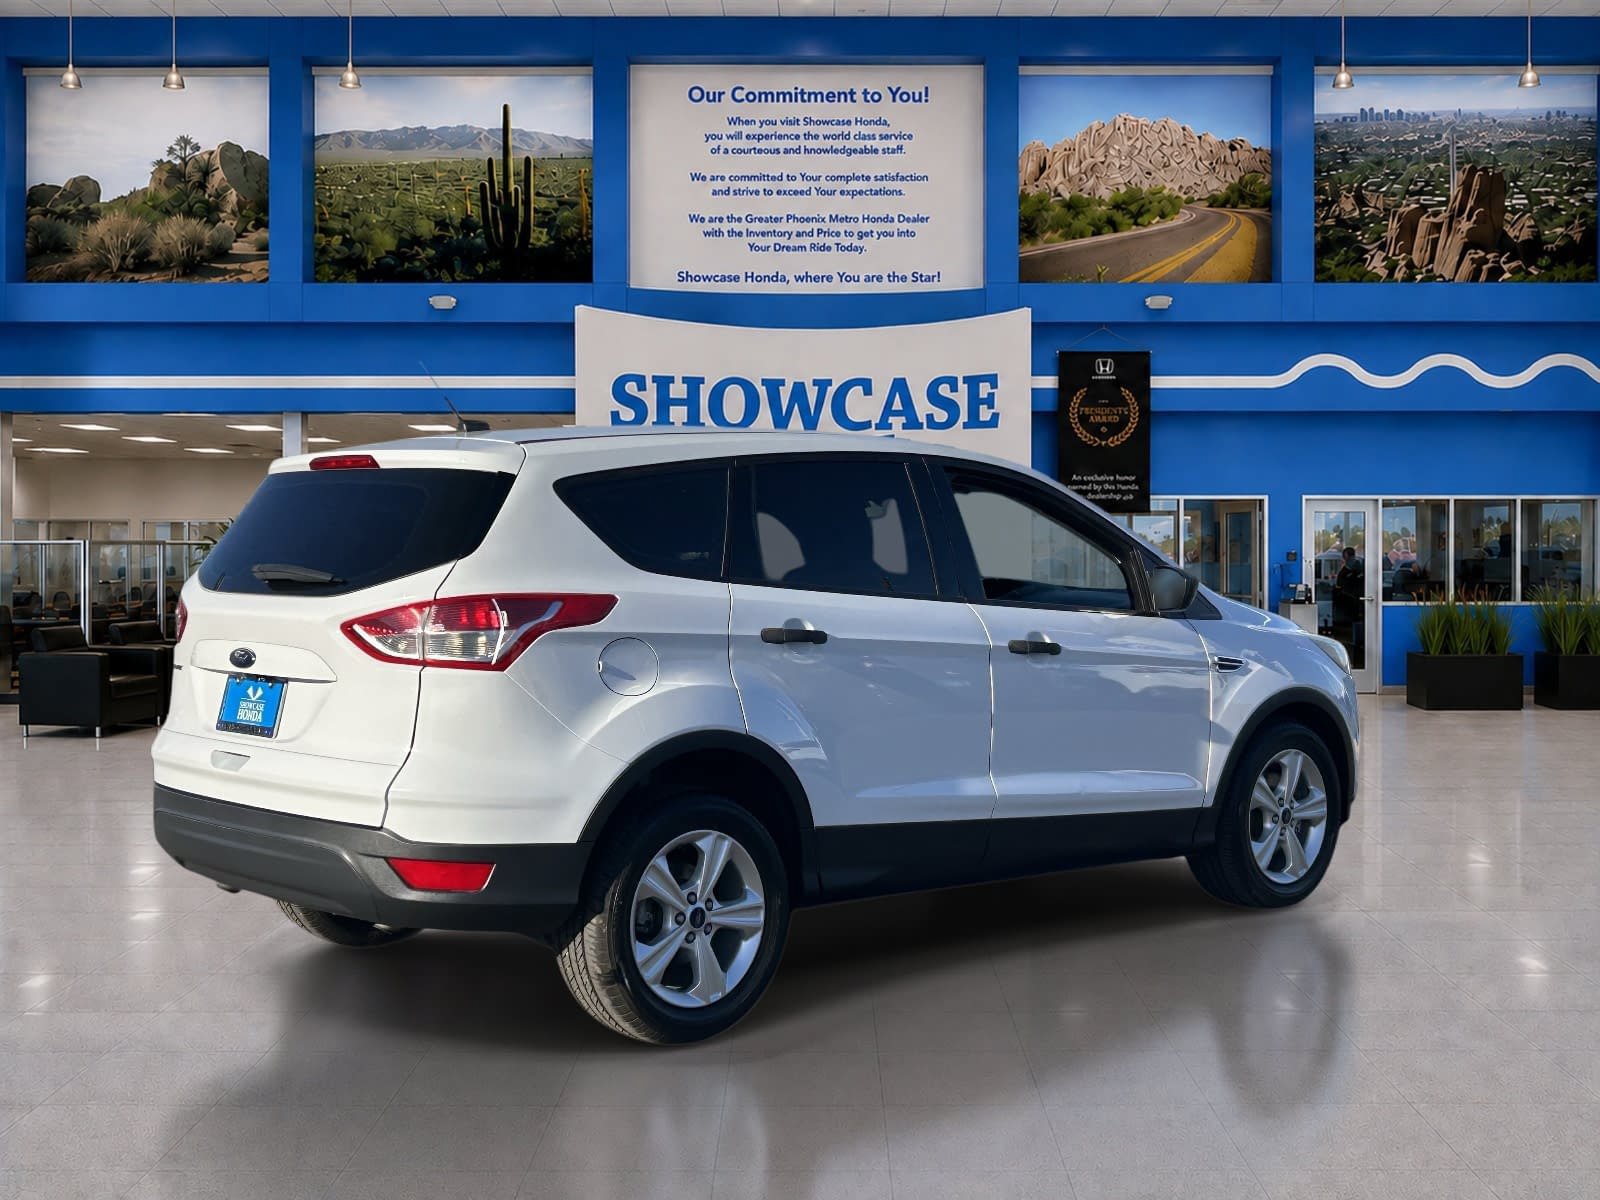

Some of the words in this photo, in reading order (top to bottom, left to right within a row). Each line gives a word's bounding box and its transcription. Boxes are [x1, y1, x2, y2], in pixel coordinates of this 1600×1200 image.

[688, 86, 726, 103] Our
[731, 86, 857, 103] Commitment
[861, 88, 882, 103] to
[887, 86, 929, 103] You!
[727, 116, 756, 126] When
[759, 119, 777, 128] you
[780, 117, 800, 126] visit
[803, 116, 852, 126] Showcase
[855, 117, 890, 127] Honda,
[705, 133, 723, 143] you
[725, 131, 742, 140] will
[745, 131, 800, 143] experience
[803, 131, 820, 140] the
[822, 131, 851, 141] world
[853, 131, 876, 141] class
[879, 131, 913, 141] service
[710, 145, 721, 154] of
[731, 147, 781, 155] courteous
[783, 145, 801, 154] and
[882, 145, 906, 154] staff.
[690, 173, 707, 182] We
[729, 172, 783, 182] committed
[786, 174, 797, 182] to
[800, 173, 822, 182] Your
[825, 172, 871, 184] complete
[874, 172, 928, 182] satisfaction
[712, 186, 730, 196] and
[733, 187, 760, 196] strive
[763, 188, 773, 196] to
[776, 187, 812, 196] exceed
[814, 187, 837, 196] Your
[839, 187, 905, 199] expectations.
[689, 214, 705, 224] We
[726, 214, 742, 223] the
[745, 214, 784, 223] Greater
[786, 214, 826, 223] Phoenix
[829, 214, 859, 223] Metro
[862, 214, 894, 223] Honda
[898, 214, 930, 223] Dealer
[703, 228, 724, 237] with
[727, 228, 743, 238] the
[746, 228, 793, 240] Inventory
[795, 228, 814, 238] and
[817, 228, 841, 238] Price
[844, 230, 854, 238] to
[857, 230, 874, 240] get
[876, 231, 894, 240] you
[897, 228, 916, 238] into
[748, 243, 771, 252] Your
[773, 243, 807, 252] Dream
[810, 242, 832, 252] Ride
[834, 243, 867, 254] Today.
[677, 271, 740, 283] Showcase
[745, 271, 790, 284] Honda,
[794, 271, 833, 283] where
[837, 272, 860, 283] You
[864, 275, 883, 283] are
[887, 271, 907, 283] the
[911, 271, 940, 283] Star!
[610, 372, 1000, 431] SHOWCASE
[240, 701, 265, 711] SHOWCASE
[237, 708, 263, 722] HONDA
